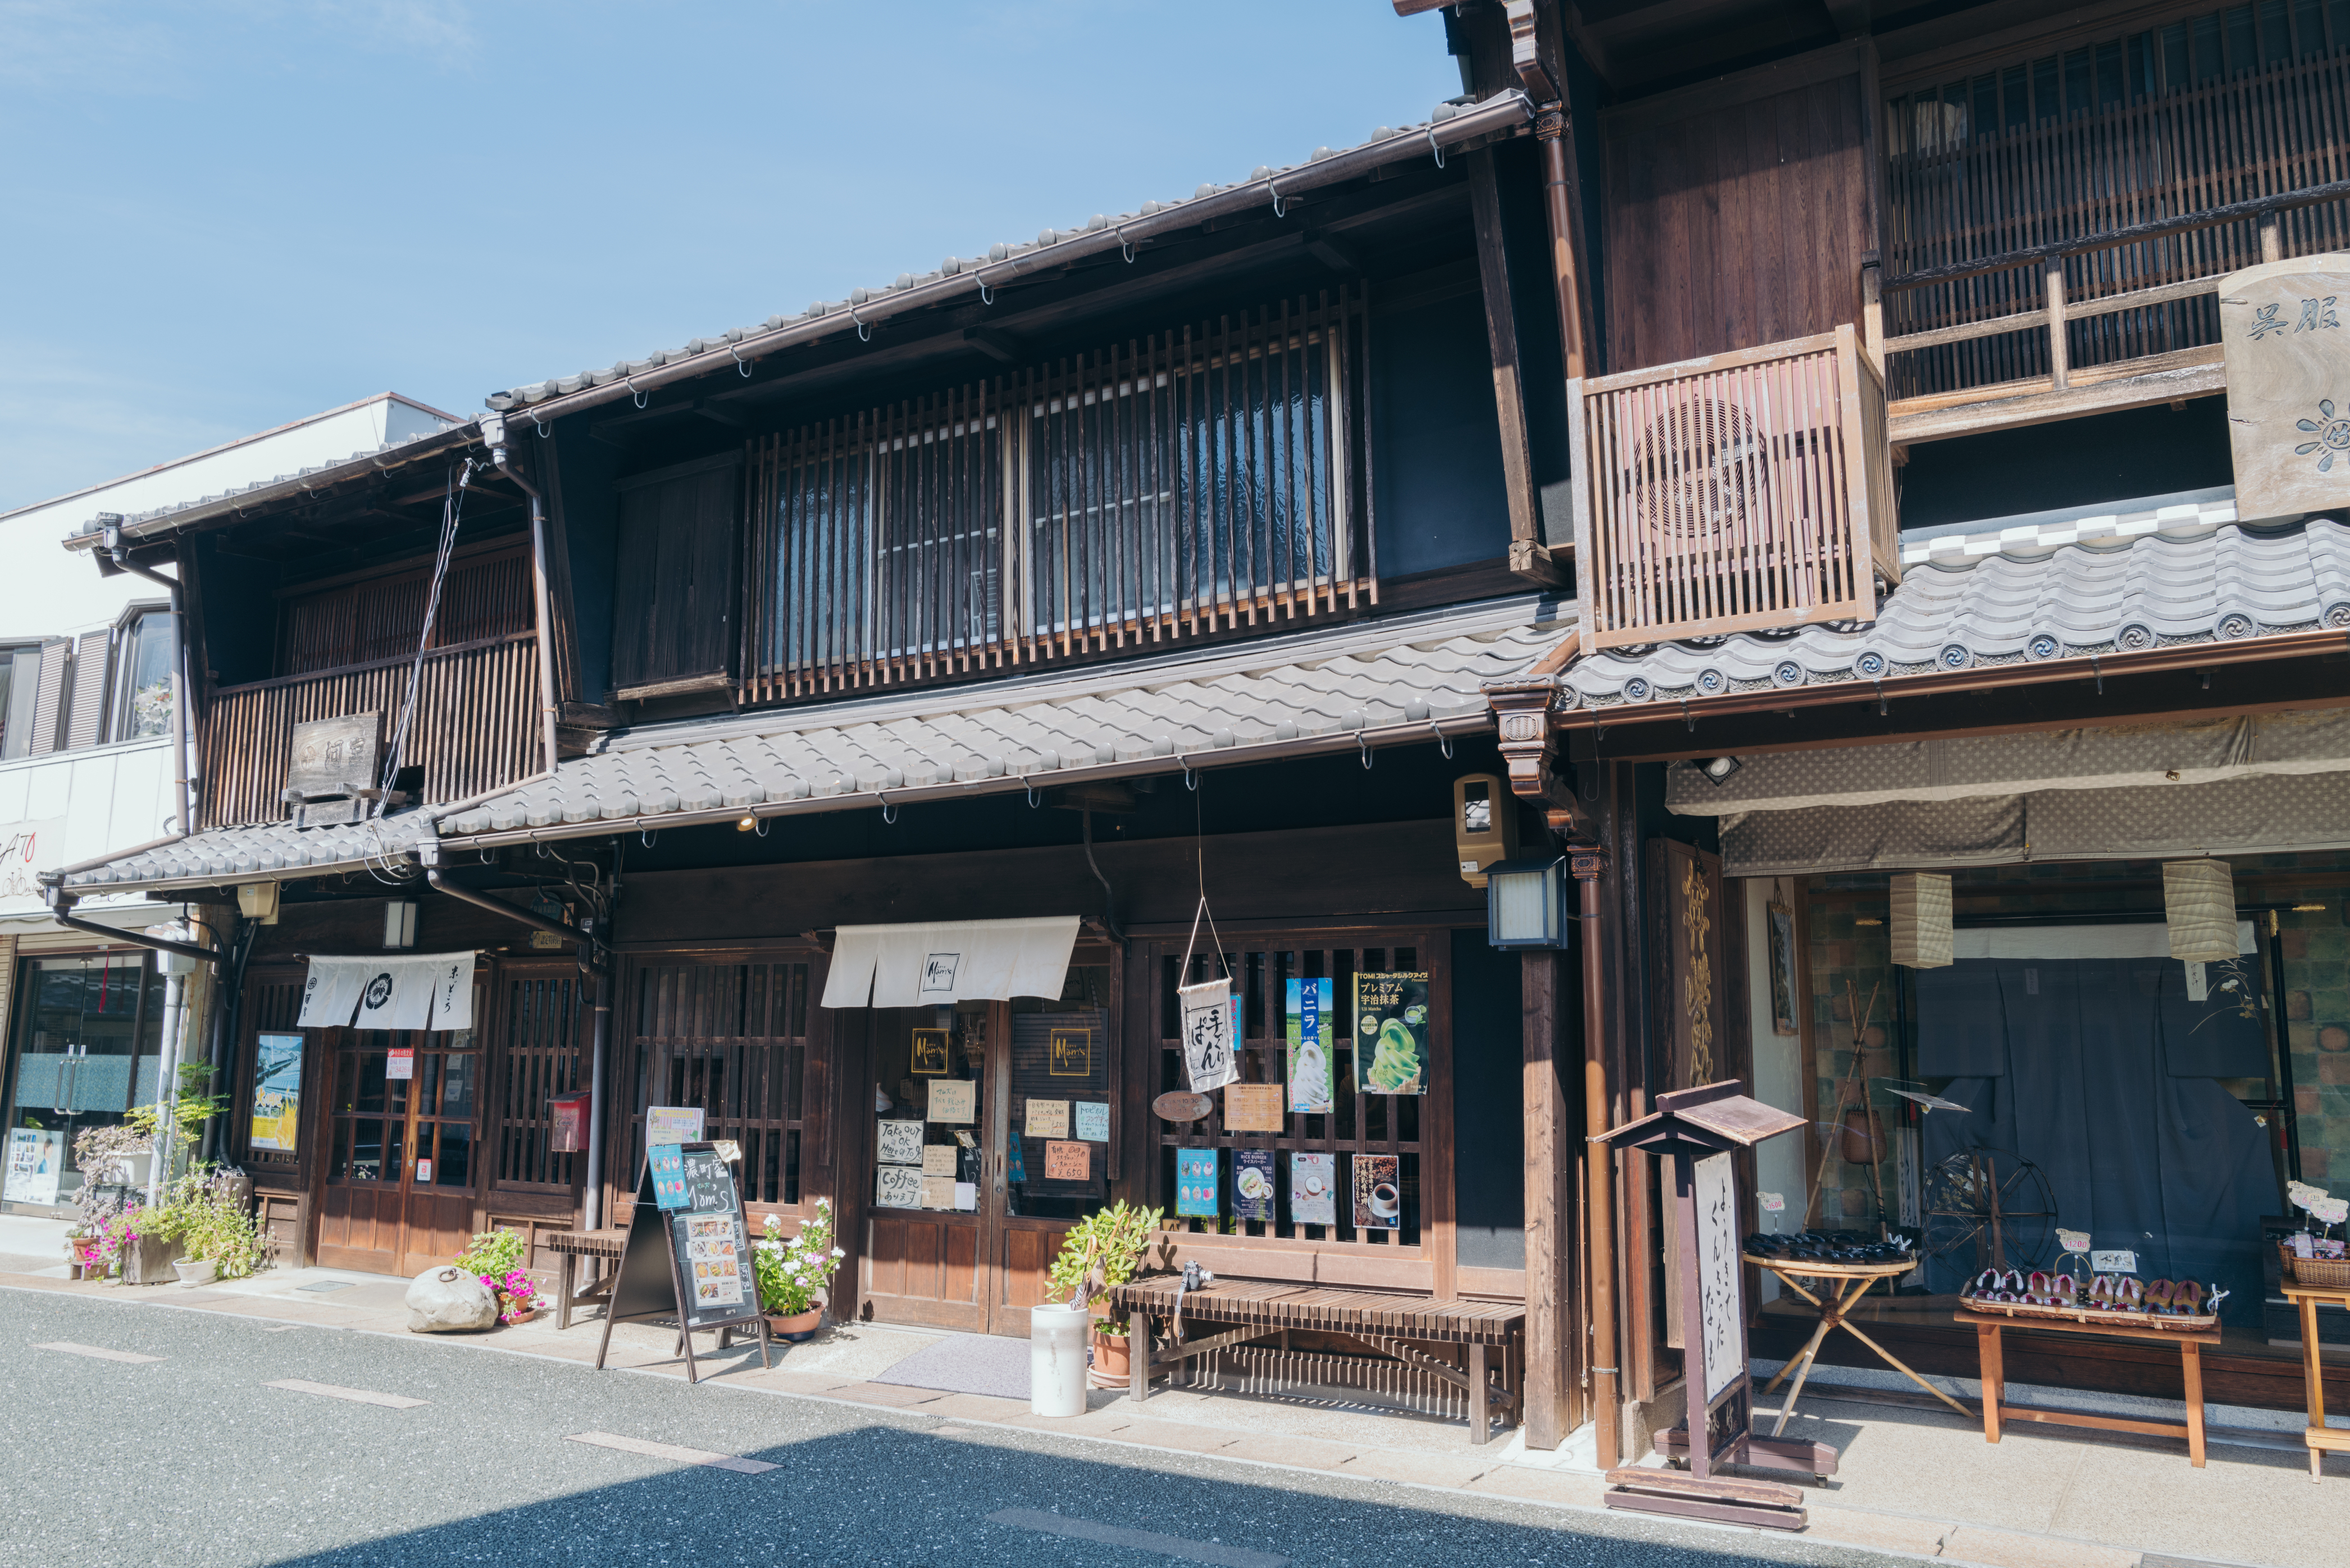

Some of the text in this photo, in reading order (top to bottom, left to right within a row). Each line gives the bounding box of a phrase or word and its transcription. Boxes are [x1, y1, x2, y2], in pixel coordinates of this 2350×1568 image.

[2247, 297, 2341, 340] 呉服
[928, 961, 952, 984] Mam's
[1361, 982, 1403, 993] プレミアム
[1302, 983, 1317, 1029] バニラ
[1361, 994, 1399, 1005] 宇治抹茶
[1191, 1017, 1216, 1070] ぱん
[1206, 1009, 1224, 1068] 手づくり
[917, 1037, 944, 1065] Mam's
[1056, 1038, 1085, 1068] Mam's
[255, 1086, 283, 1107] 火の用心
[1080, 1105, 1108, 1116] トロピカル
[882, 1123, 902, 1137] Take
[880, 1143, 899, 1155] Here
[882, 1169, 920, 1189] Coffee
[884, 1189, 916, 1205] あります
